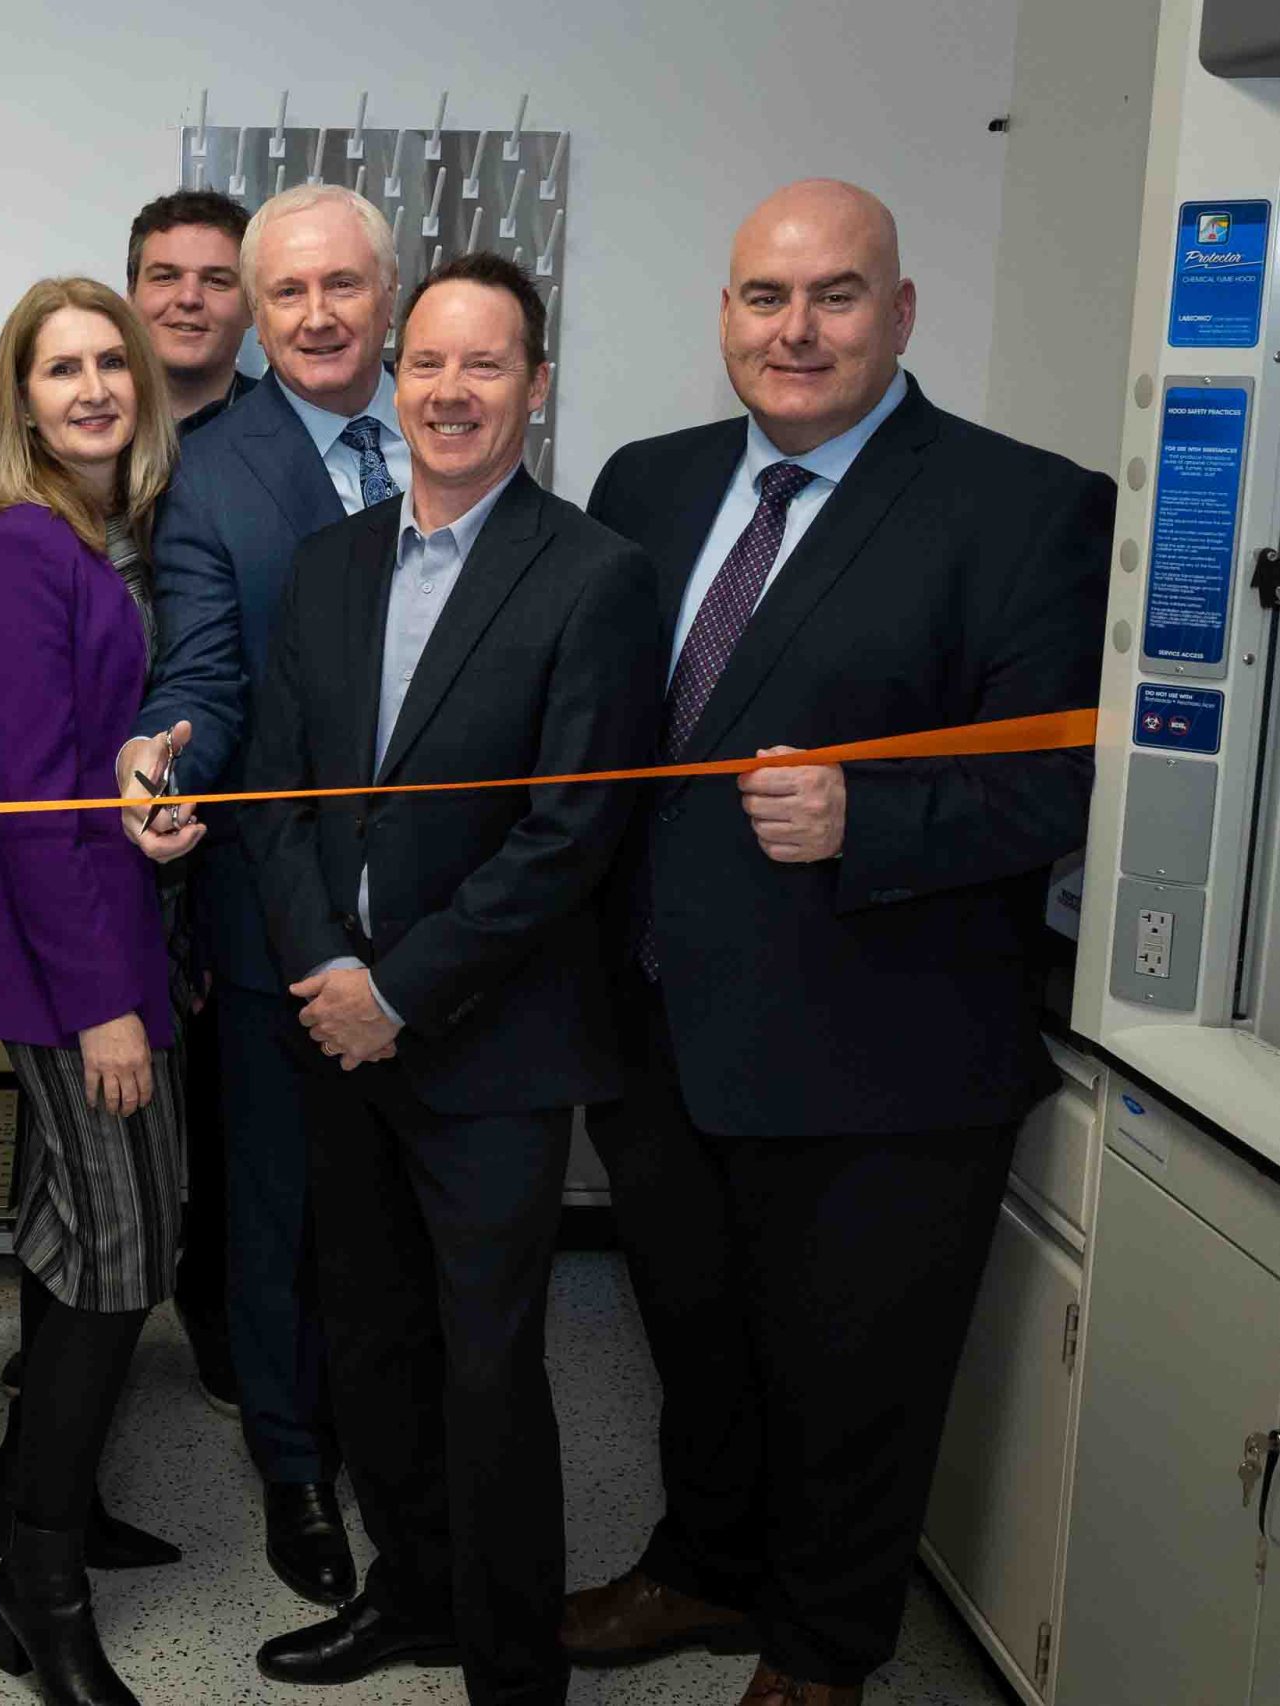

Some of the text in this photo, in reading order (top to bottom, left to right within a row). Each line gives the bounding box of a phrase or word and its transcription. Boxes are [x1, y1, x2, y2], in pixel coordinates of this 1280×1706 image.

[1184, 250, 1242, 264] Protector
[1168, 407, 1241, 416] HOOD SAFETY PRACTICES
[1158, 649, 1180, 657] SERVICE
